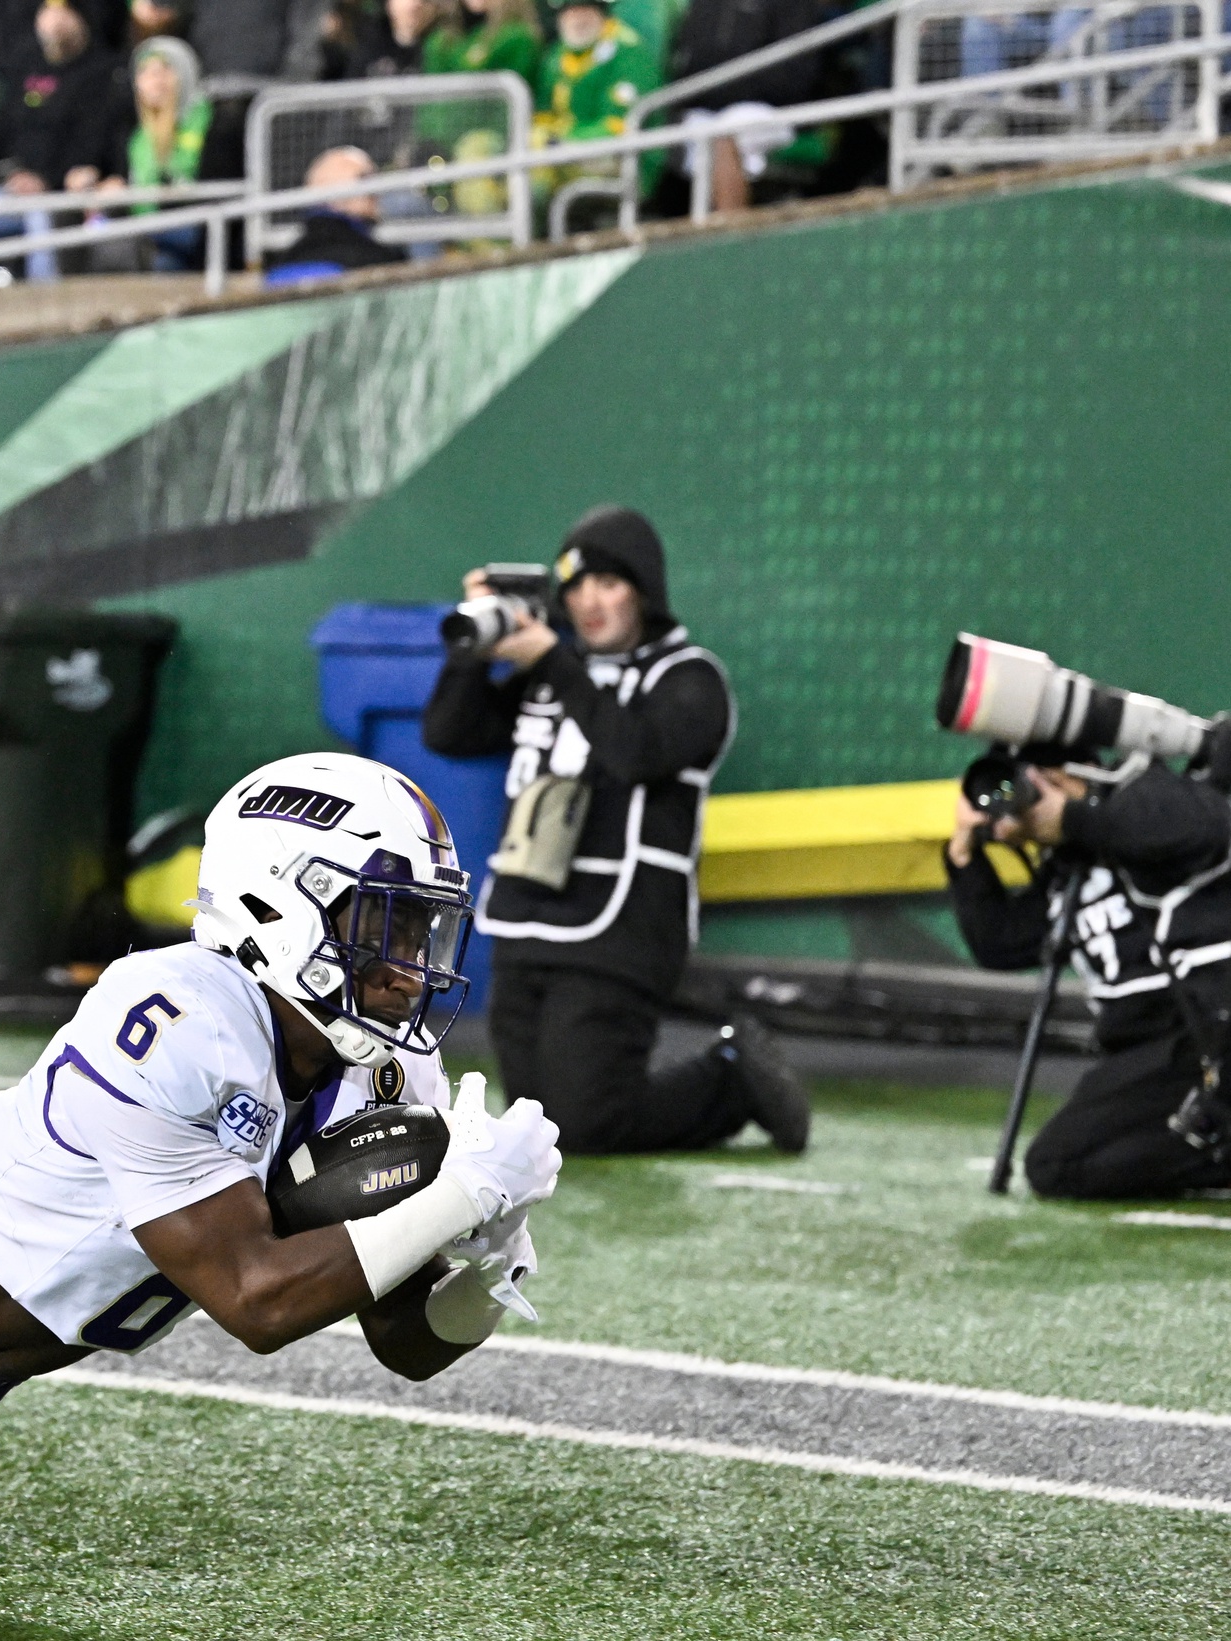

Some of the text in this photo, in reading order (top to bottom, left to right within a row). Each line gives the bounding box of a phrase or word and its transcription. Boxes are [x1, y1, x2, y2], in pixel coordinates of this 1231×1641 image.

[239, 786, 355, 831] JMU
[113, 990, 188, 1065] 6
[361, 1160, 420, 1194] JMU
